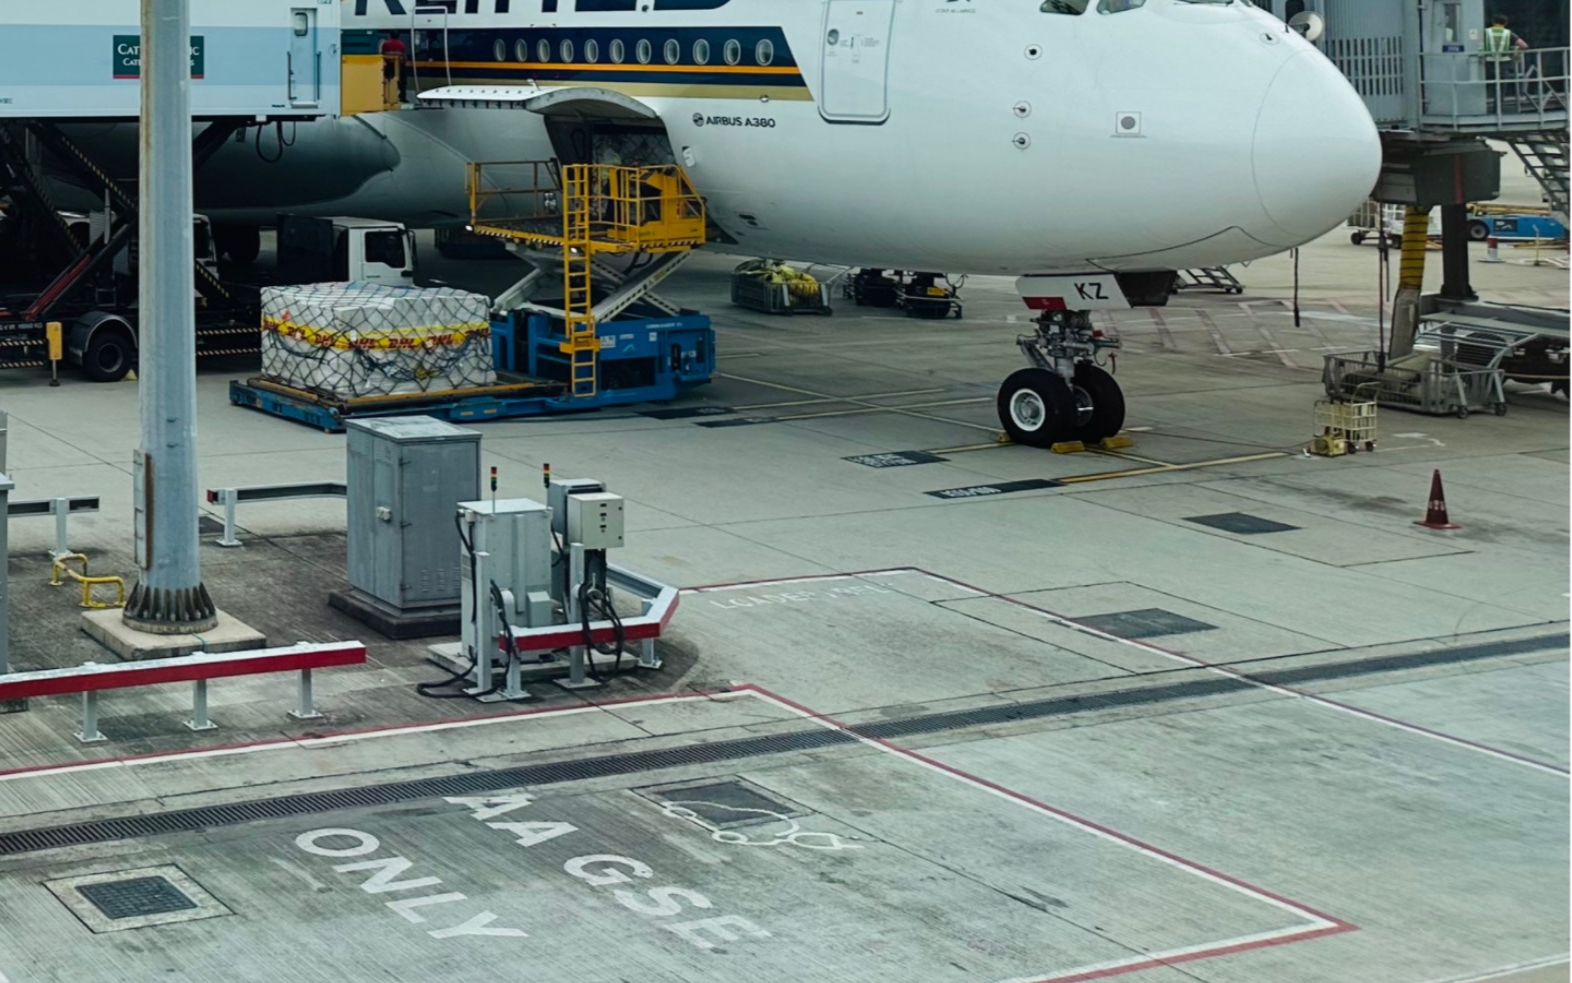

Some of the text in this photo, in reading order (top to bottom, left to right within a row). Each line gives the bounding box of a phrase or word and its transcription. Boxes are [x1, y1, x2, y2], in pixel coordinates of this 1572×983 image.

[706, 116, 776, 129] AIRBUS A380
[1074, 282, 1109, 300] KZ
[388, 337, 416, 349] DHL
[442, 795, 772, 950] AA GSE
[295, 828, 529, 939] ONLY
